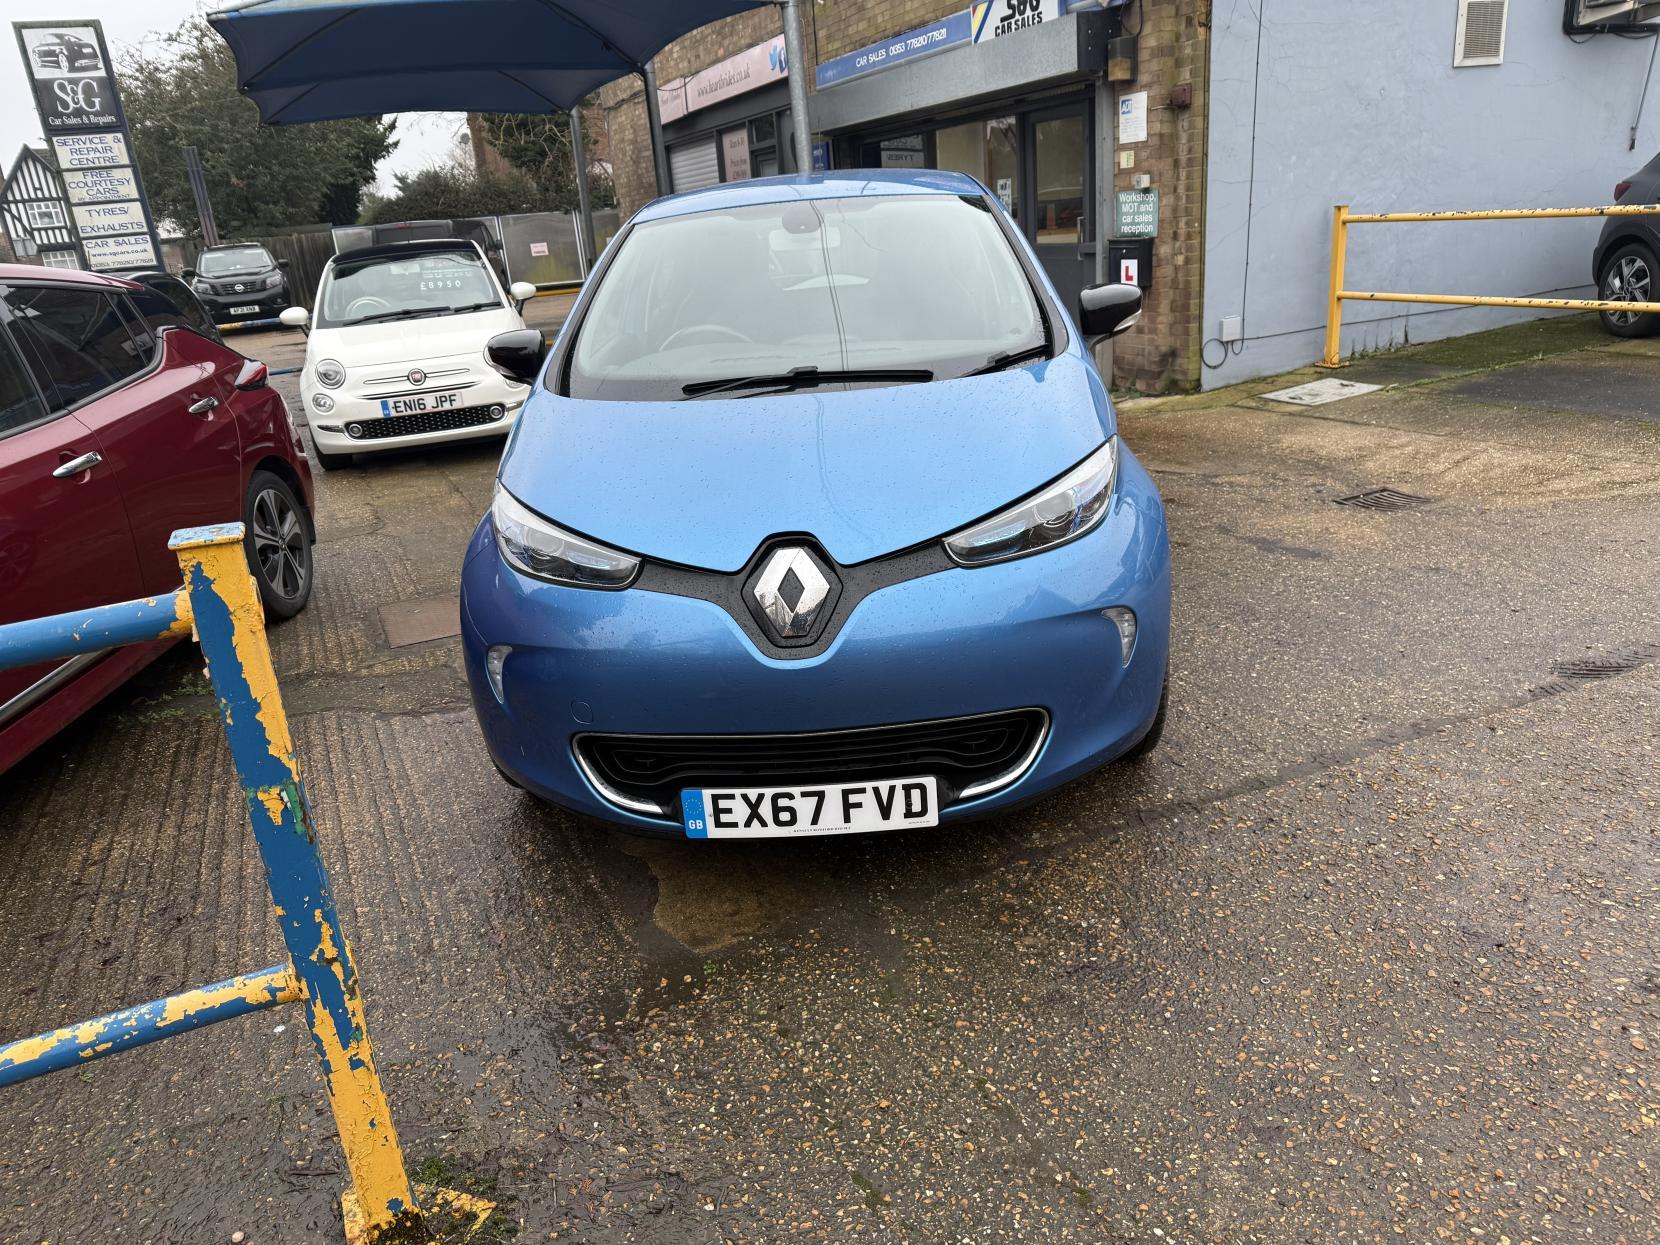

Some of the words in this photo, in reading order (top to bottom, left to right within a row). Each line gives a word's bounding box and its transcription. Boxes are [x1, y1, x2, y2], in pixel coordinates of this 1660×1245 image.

[995, 21, 1013, 38] CAR
[1014, 11, 1043, 31] SALES
[855, 56, 868, 67] CAR
[868, 49, 887, 63] SALES
[889, 42, 906, 56] 01353
[53, 79, 102, 113] S&G
[48, 116, 62, 125] Car
[62, 115, 81, 125] Sales
[82, 115, 89, 123] &
[90, 114, 116, 125] Repairs
[55, 136, 108, 147] SERVICE
[112, 135, 122, 144] &
[69, 146, 114, 157] REPAIR
[69, 155, 120, 166] CENTRE
[82, 169, 114, 179] FREE
[68, 177, 131, 189] COURTESY
[86, 187, 119, 196] CARS
[86, 206, 129, 217] TYRES/
[1121, 203, 1139, 213] MOT
[1139, 203, 1153, 212] and
[1122, 214, 1133, 223] car
[1134, 213, 1153, 222] sales
[80, 221, 145, 234] EXHAUSTS
[1121, 224, 1154, 234] reception
[85, 240, 110, 249] CAR
[113, 236, 149, 247] SALES
[1125, 266, 1133, 281] L
[393, 397, 427, 413] EN16
[431, 393, 457, 409] JPF
[710, 790, 826, 829] EX67
[840, 782, 929, 824] FVD
[688, 819, 704, 830] GB
